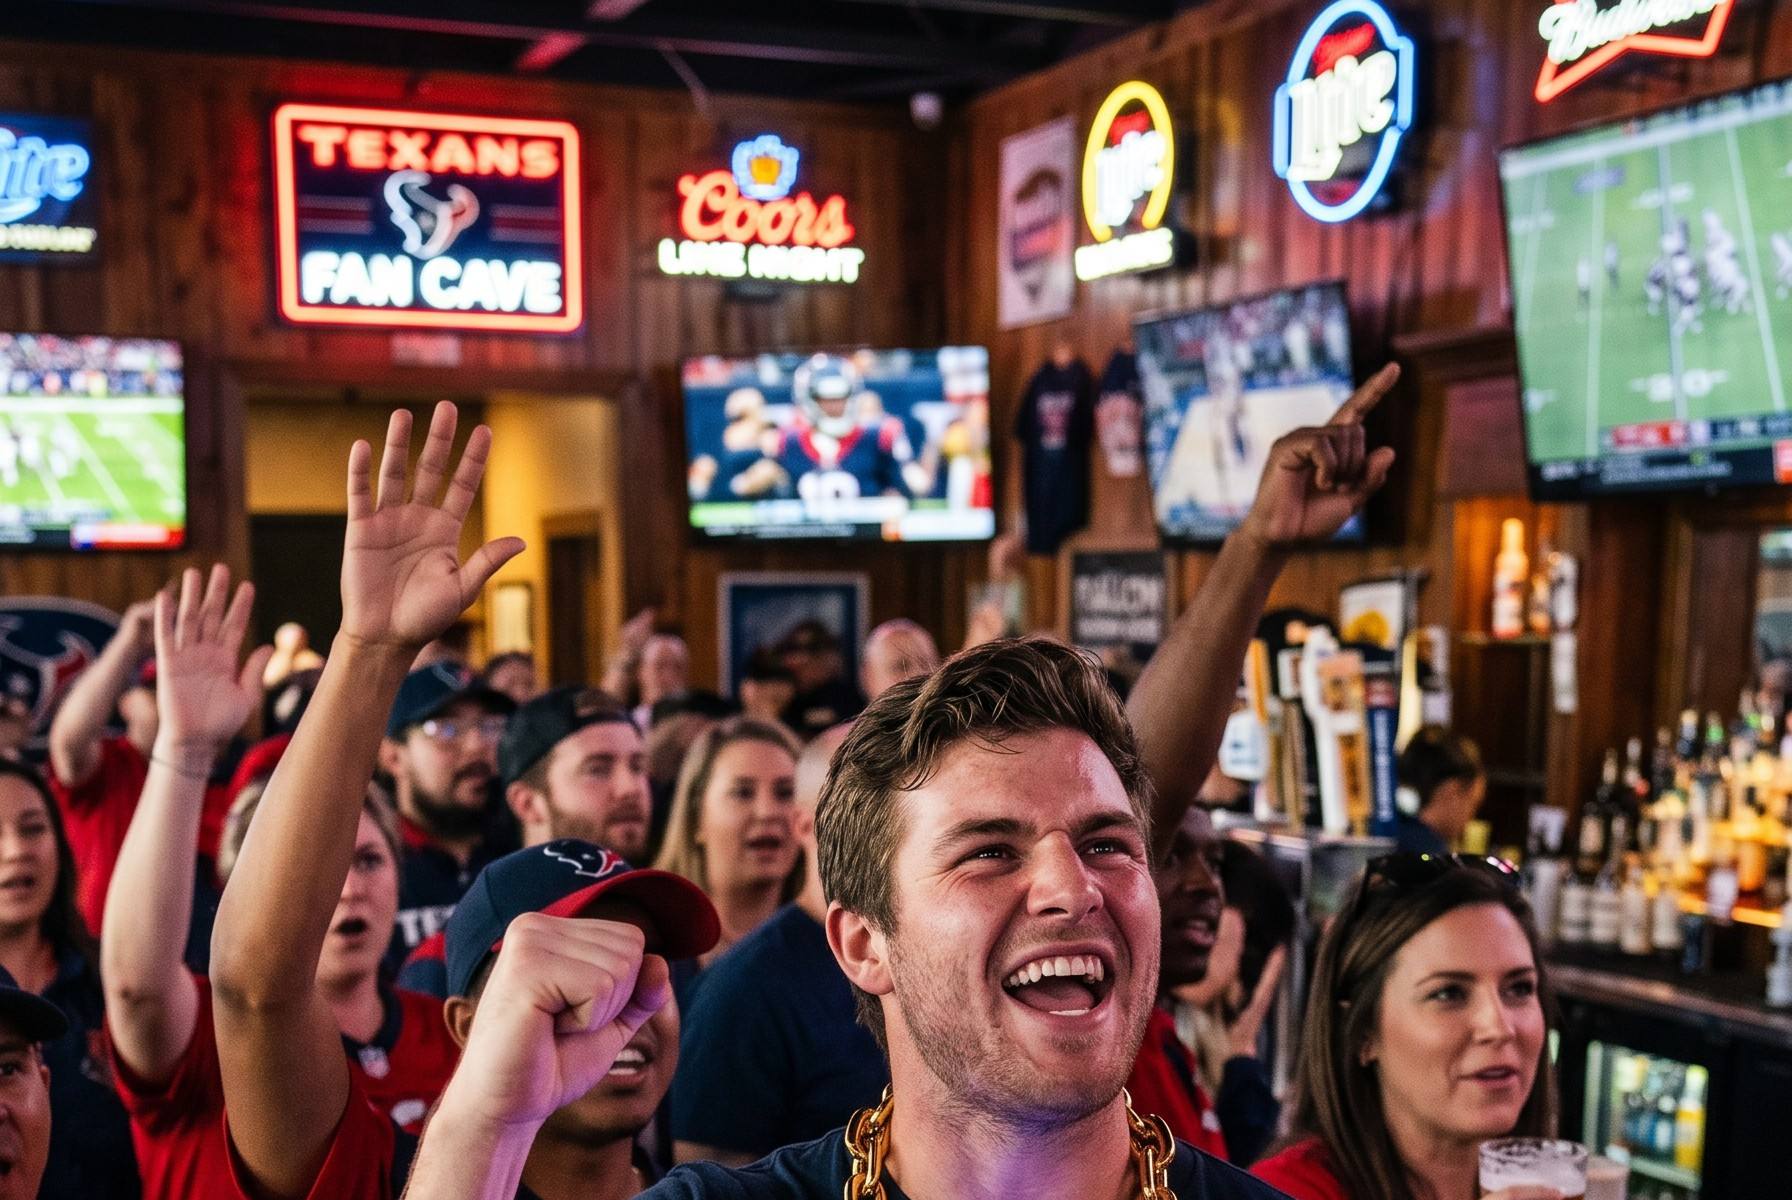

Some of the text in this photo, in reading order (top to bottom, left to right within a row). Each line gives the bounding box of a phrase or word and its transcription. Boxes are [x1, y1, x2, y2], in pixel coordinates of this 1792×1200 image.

[299, 125, 560, 179] TEXANS
[677, 169, 855, 249] Coors
[302, 250, 563, 314] FAN CAVE
